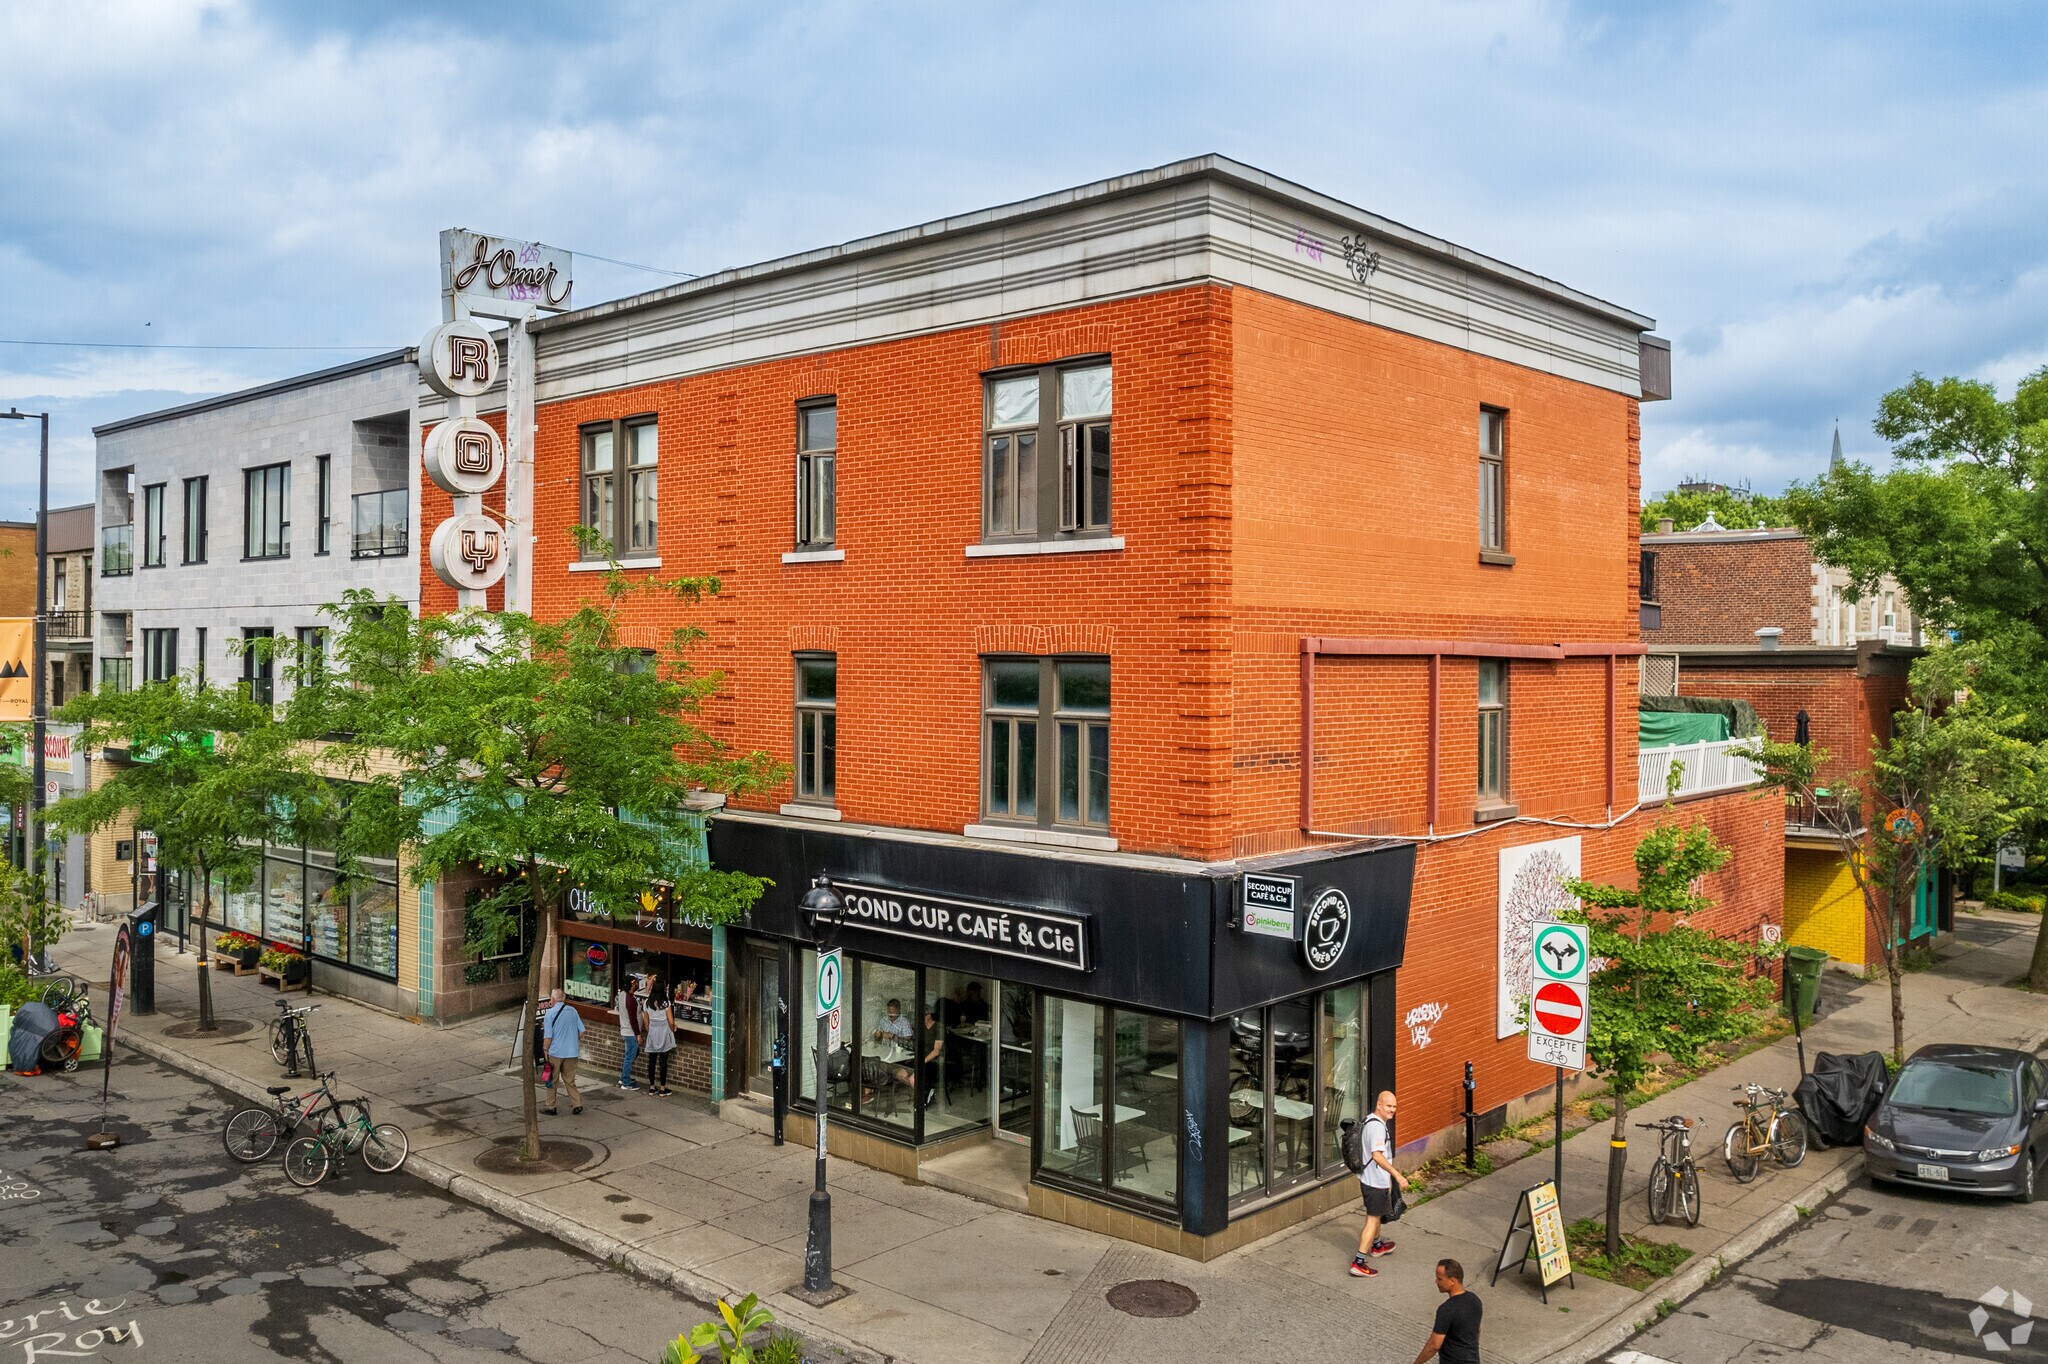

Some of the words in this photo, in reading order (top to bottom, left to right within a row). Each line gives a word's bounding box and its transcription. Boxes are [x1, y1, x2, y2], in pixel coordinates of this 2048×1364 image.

[1247, 882, 1276, 893] SECOND
[1251, 891, 1269, 900] CAFÉ
[1269, 893, 1276, 901] &
[1275, 894, 1287, 903] Cie
[1311, 896, 1337, 926] SECOND
[1336, 900, 1347, 920] CUP
[655, 917, 665, 932] &
[1255, 917, 1292, 930] pinkberry
[957, 913, 1011, 943] CAFÉ
[1018, 922, 1035, 947] &
[1038, 926, 1075, 953] Cie
[1310, 946, 1325, 964] CAFÉ
[1330, 941, 1342, 957] Cie
[564, 980, 610, 1002] CHURROS
[1536, 1035, 1577, 1052] EXCEPTE
